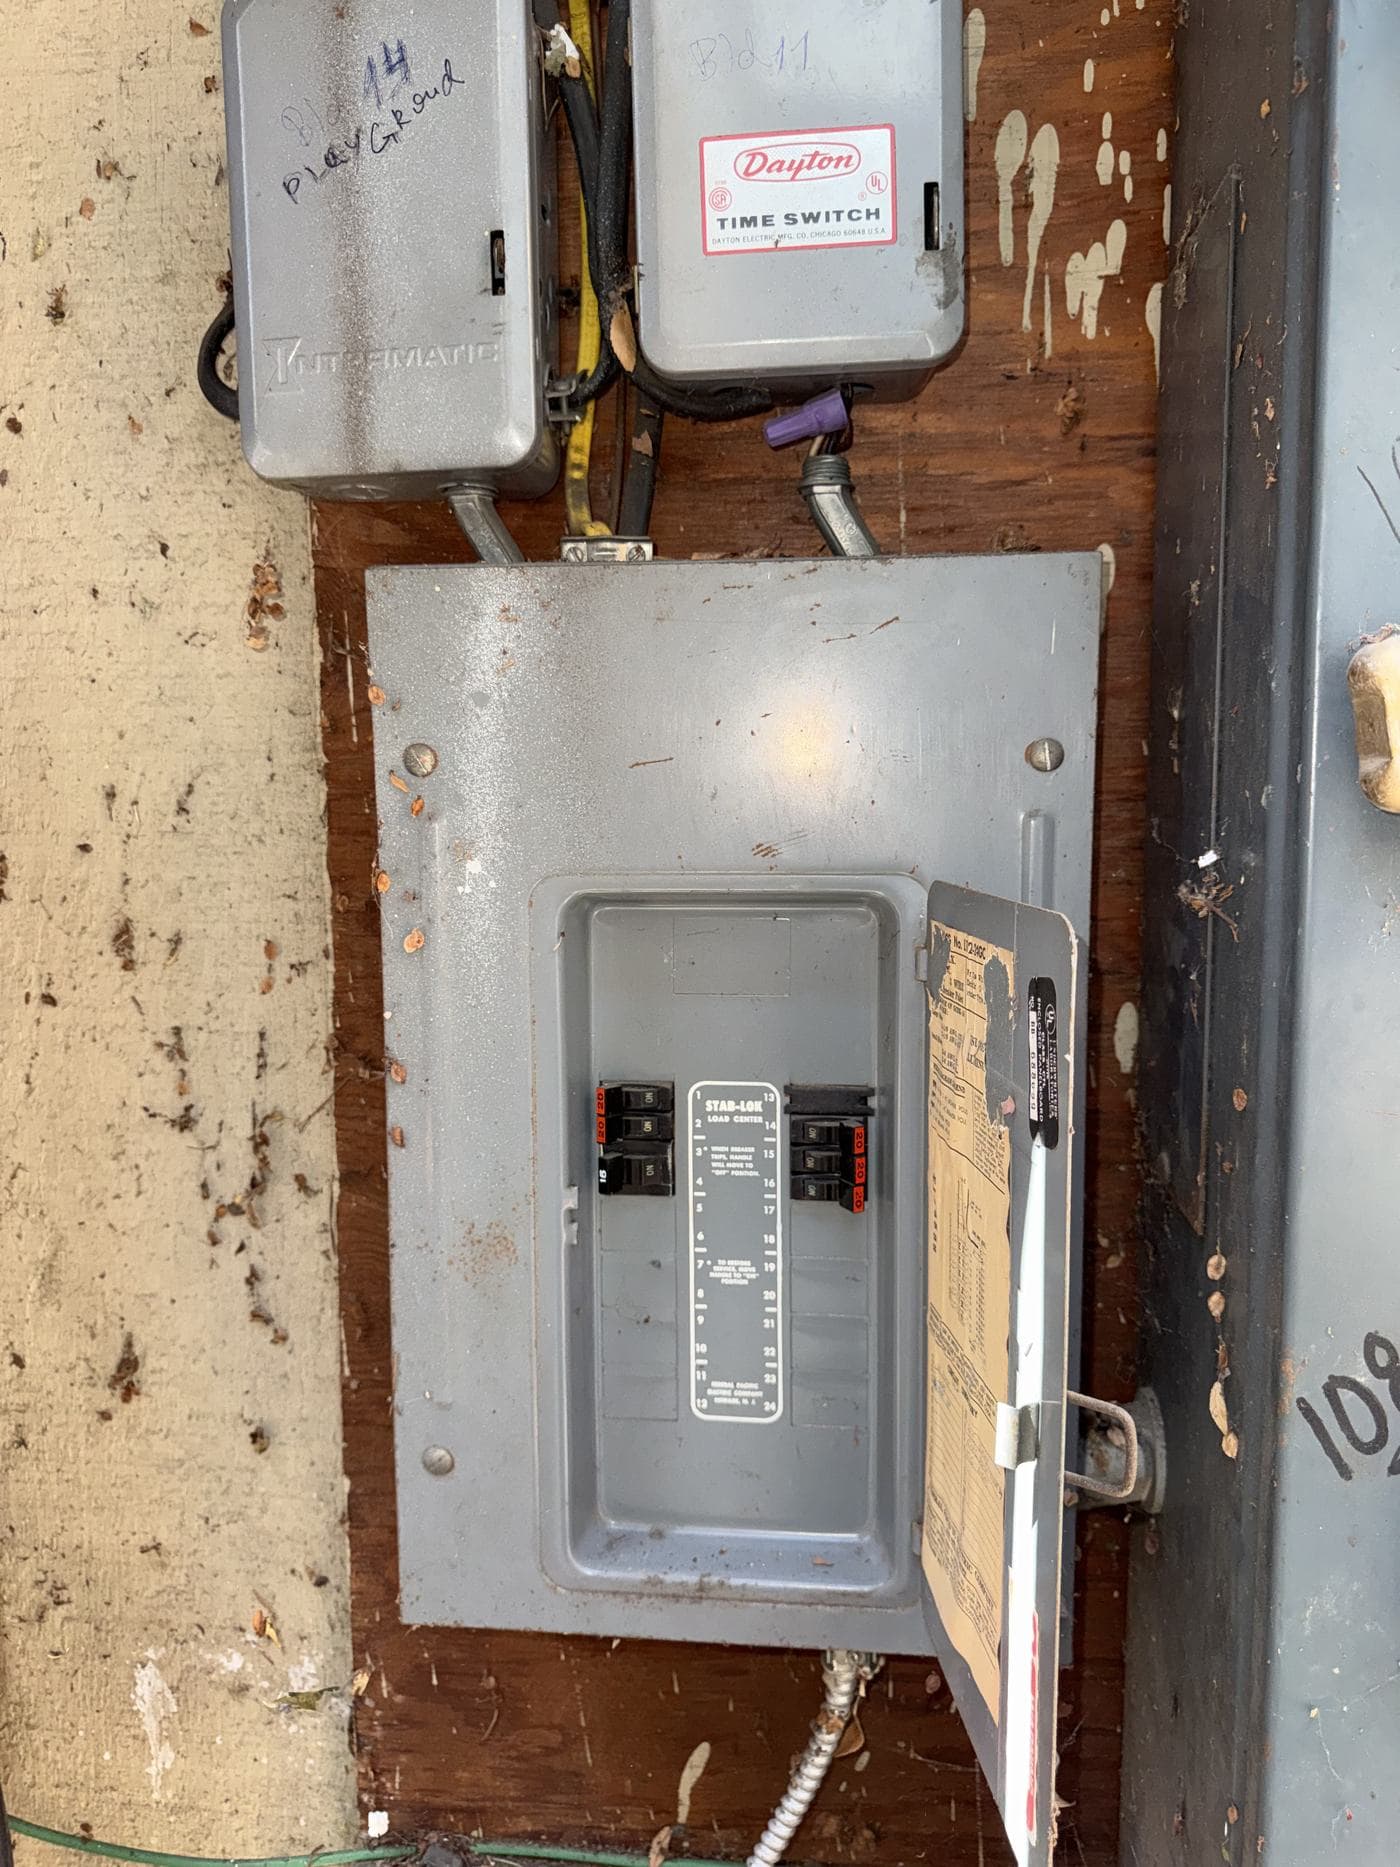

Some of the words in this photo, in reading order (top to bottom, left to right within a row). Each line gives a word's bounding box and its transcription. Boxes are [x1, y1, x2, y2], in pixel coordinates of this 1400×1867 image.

[772, 31, 808, 74] 11
[743, 150, 855, 181] Dayton
[717, 214, 775, 230] TIME
[784, 207, 881, 226] SWITCH
[712, 236, 741, 246] DAYTON
[743, 233, 775, 243] ELECTRIC
[810, 229, 842, 239] CHICAGO
[645, 1092, 653, 1103] ON
[696, 1090, 701, 1100] 1
[763, 1092, 775, 1102] 13
[705, 1100, 763, 1112] STAB-LOK
[695, 1118, 702, 1128] 2
[708, 1115, 730, 1123] LOAD
[733, 1115, 763, 1123] CENTER
[643, 1121, 652, 1132] ON
[765, 1121, 776, 1130] 14
[696, 1147, 702, 1156] 3
[763, 1149, 775, 1159] 15
[696, 1177, 703, 1186] 4
[764, 1178, 775, 1188] 16
[696, 1203, 703, 1212] 5
[763, 1205, 775, 1215] 17
[697, 1231, 704, 1240] 6
[763, 1234, 775, 1244] 18
[697, 1259, 704, 1269] 7
[764, 1262, 776, 1272] 19
[697, 1288, 704, 1298] 8
[763, 1290, 776, 1300] 20
[697, 1315, 704, 1325] 9
[763, 1319, 775, 1328] 21
[696, 1343, 707, 1353] 10
[763, 1347, 776, 1357] 22
[696, 1370, 706, 1381] 11
